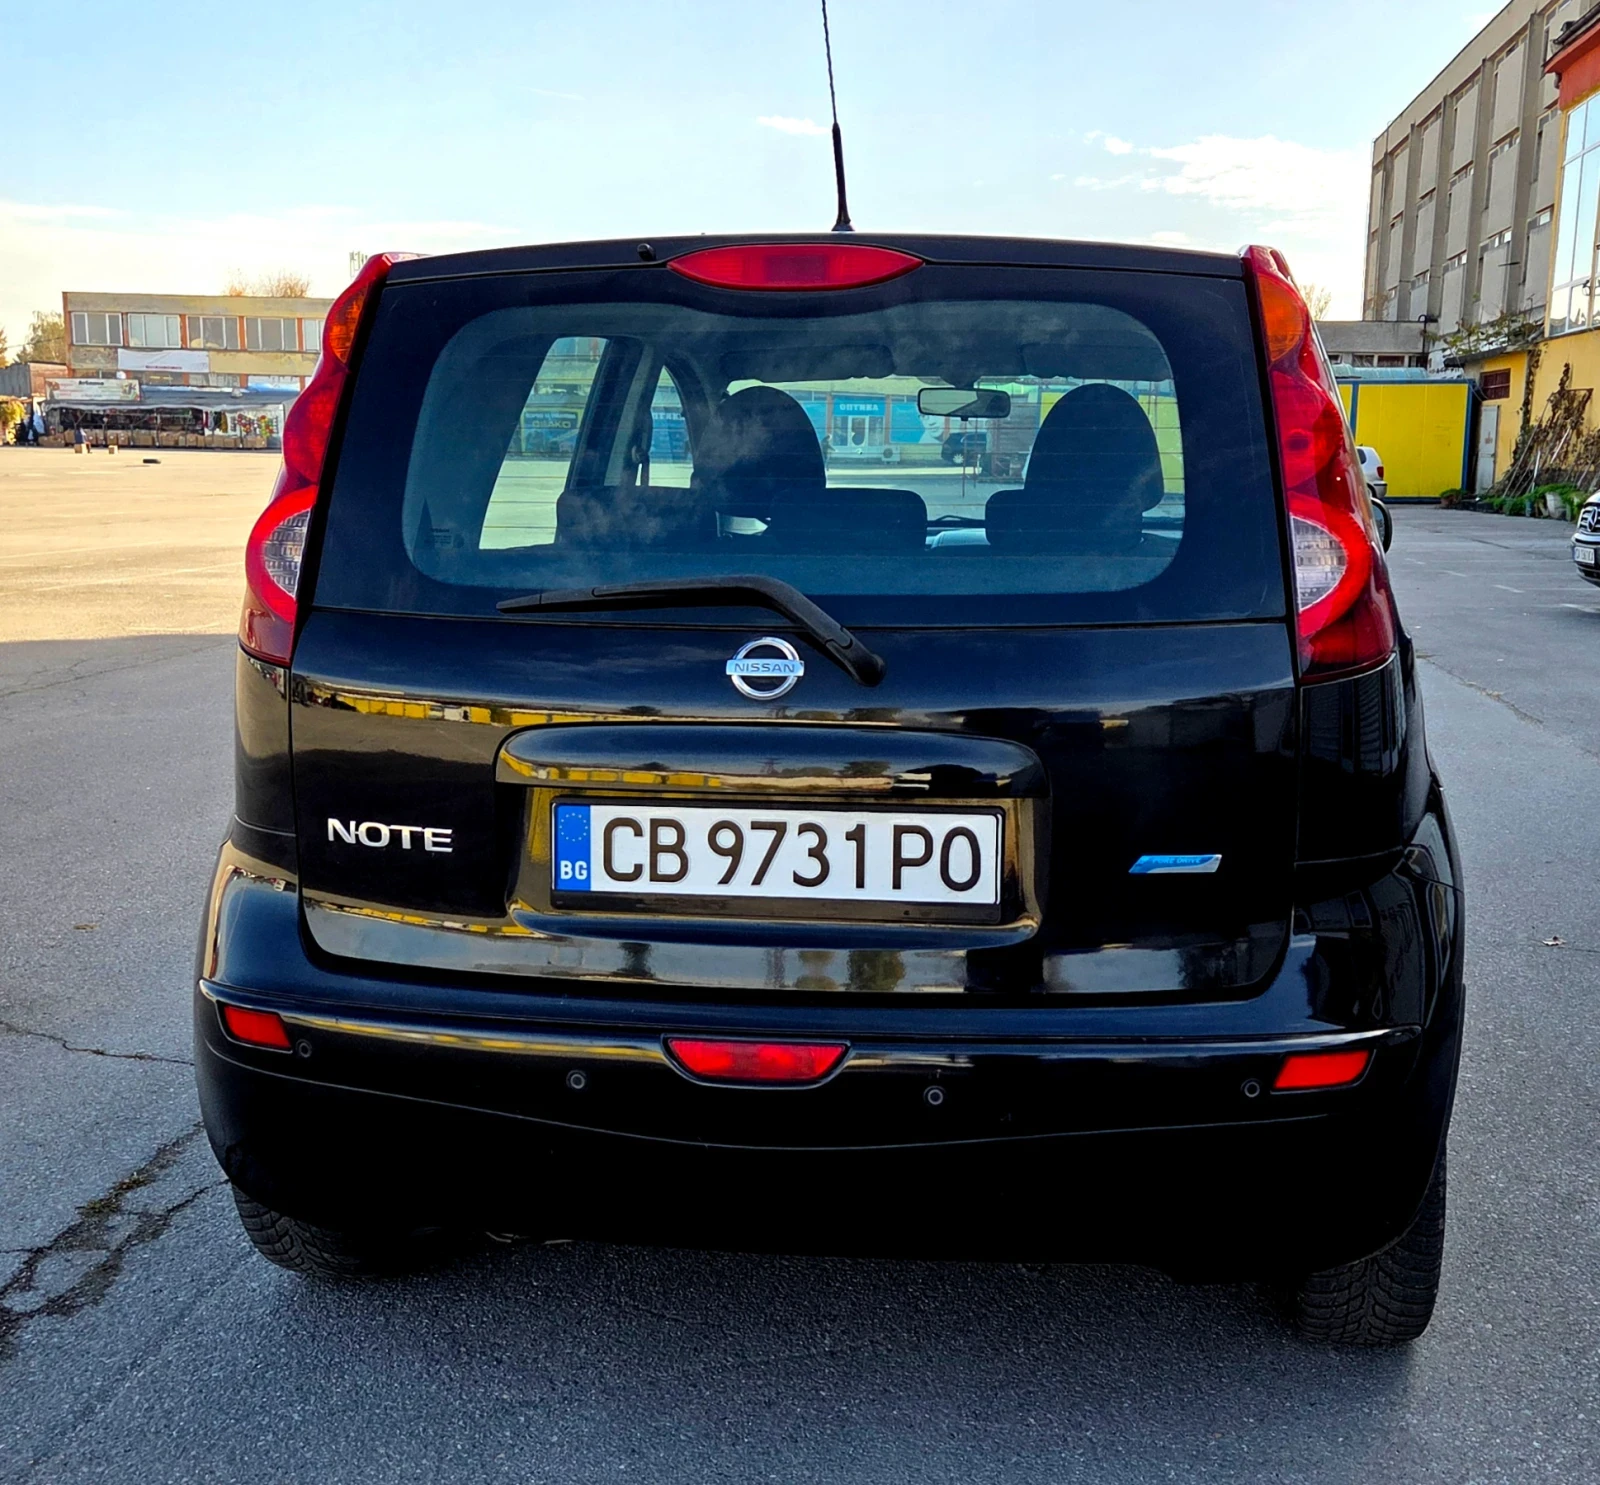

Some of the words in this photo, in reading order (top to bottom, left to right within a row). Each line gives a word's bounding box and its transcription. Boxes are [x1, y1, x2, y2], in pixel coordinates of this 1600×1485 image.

[734, 662, 795, 673] NISSAN
[327, 818, 453, 852] NOTE
[603, 817, 689, 882] CB
[707, 820, 865, 888] 9731
[560, 860, 588, 880] BG
